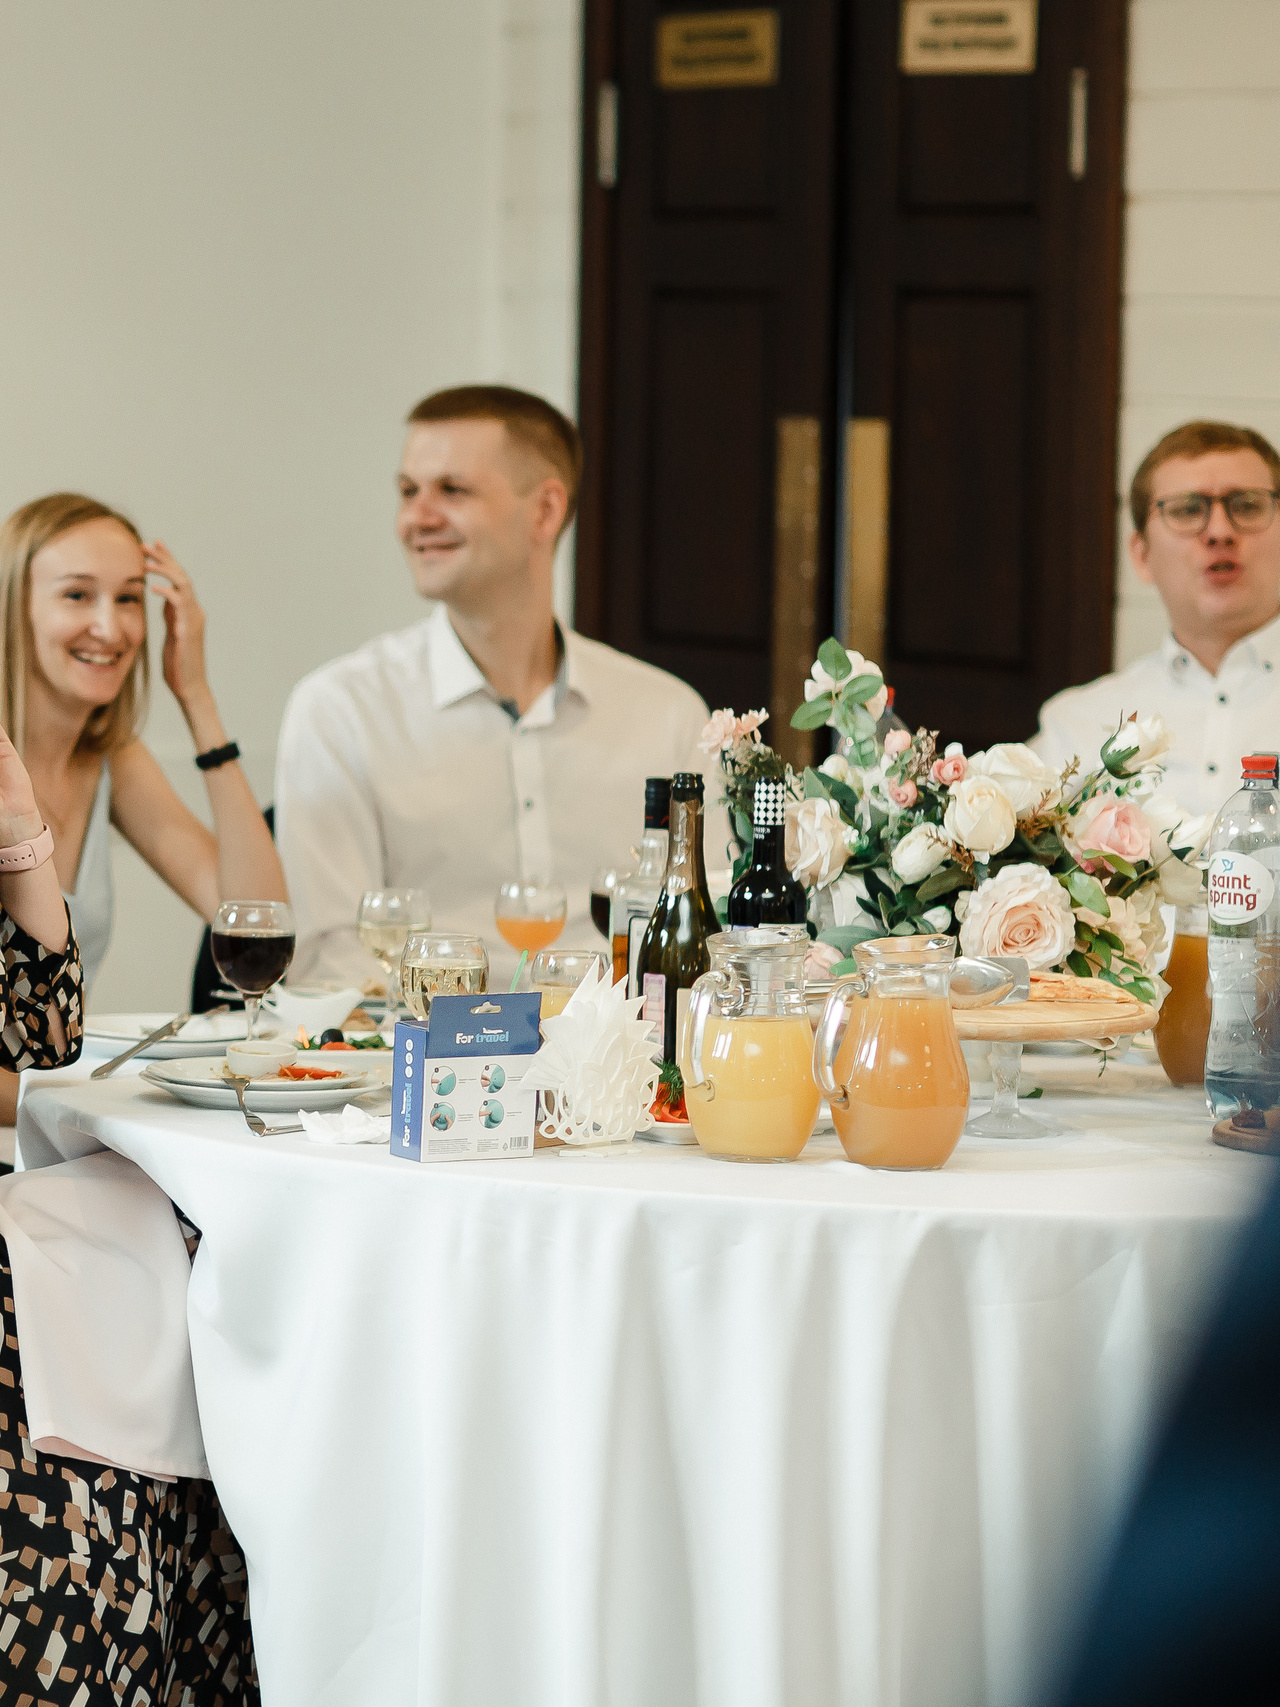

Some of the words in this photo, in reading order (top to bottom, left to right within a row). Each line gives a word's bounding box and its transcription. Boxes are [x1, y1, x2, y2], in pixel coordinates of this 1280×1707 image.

[1212, 874, 1252, 890] saint
[1209, 889, 1257, 911] spring
[455, 1032, 475, 1045] For
[475, 1030, 510, 1043] travel
[404, 1082, 412, 1124] travel
[402, 1125, 411, 1148] For
